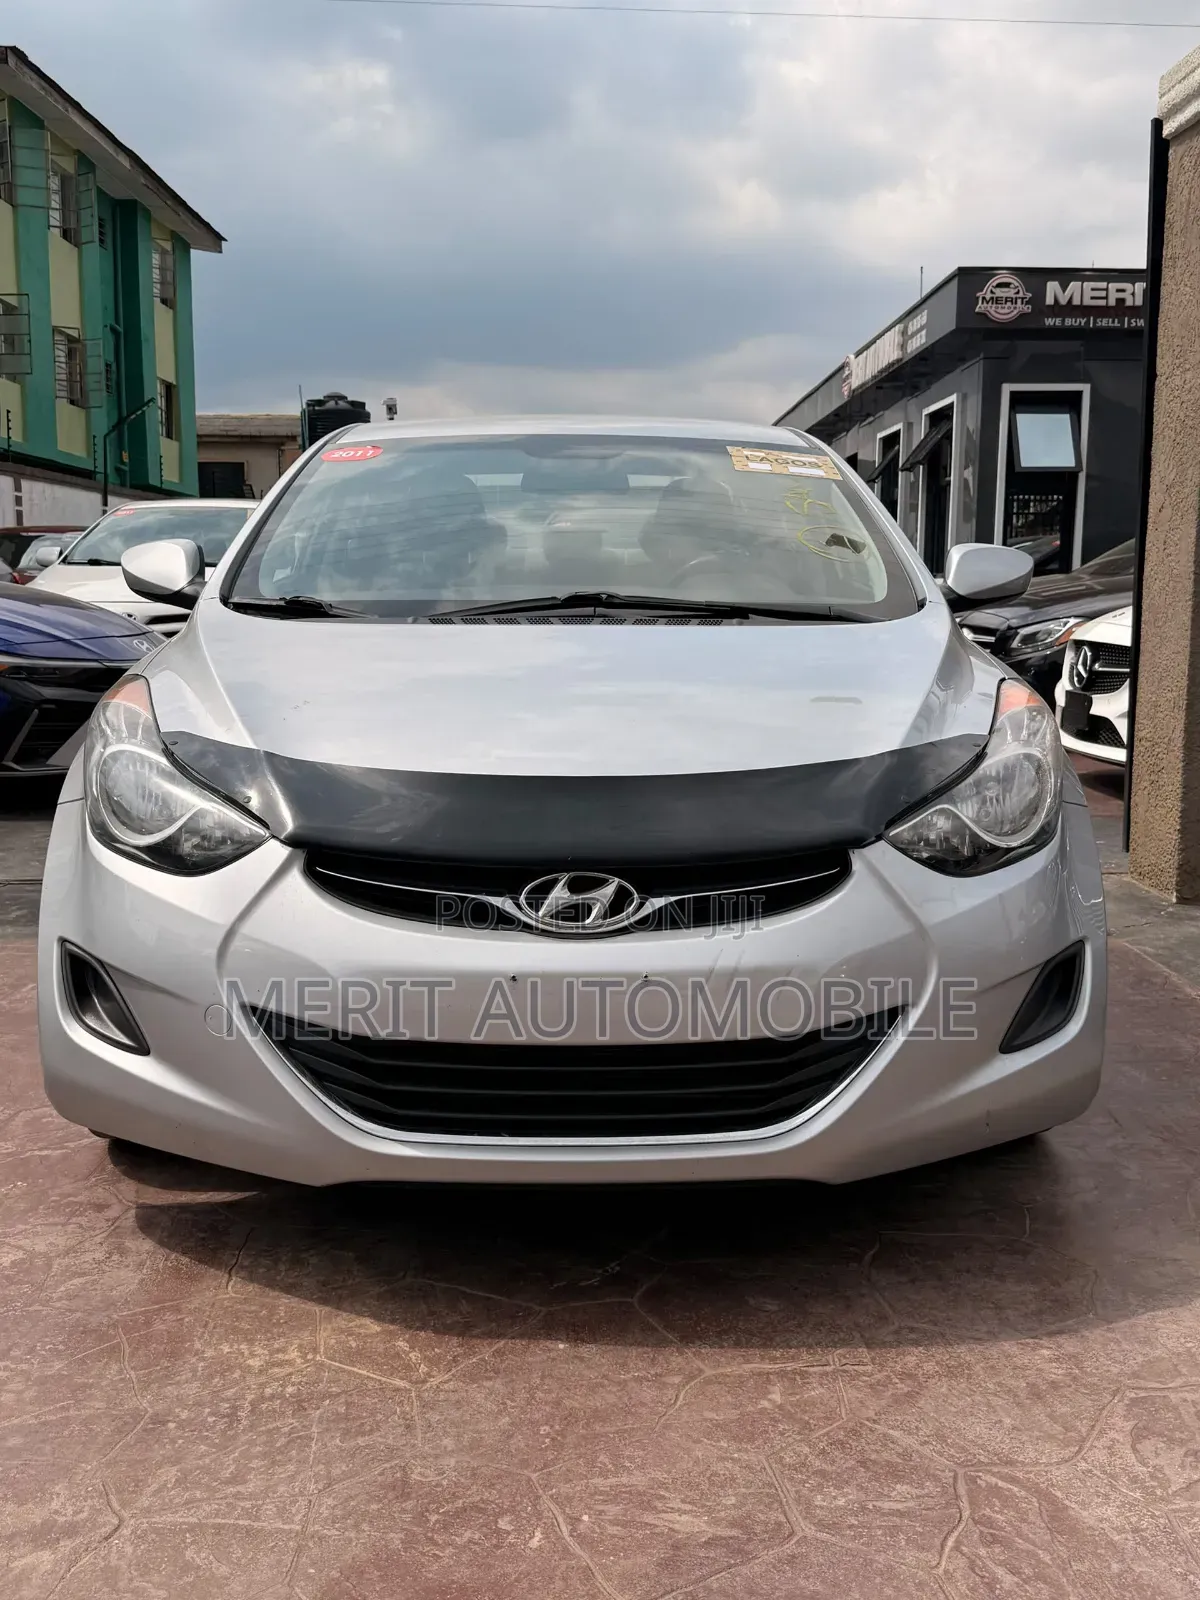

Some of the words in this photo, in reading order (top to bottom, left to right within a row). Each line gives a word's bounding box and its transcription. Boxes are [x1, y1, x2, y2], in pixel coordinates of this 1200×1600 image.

[1045, 281, 1146, 306] MERI
[981, 296, 1028, 305] MERIT
[1044, 317, 1062, 326] WE
[1064, 317, 1087, 326] BUY
[1096, 318, 1121, 327] SELL
[331, 450, 374, 458] 2011
[745, 453, 824, 469] LAGOS
